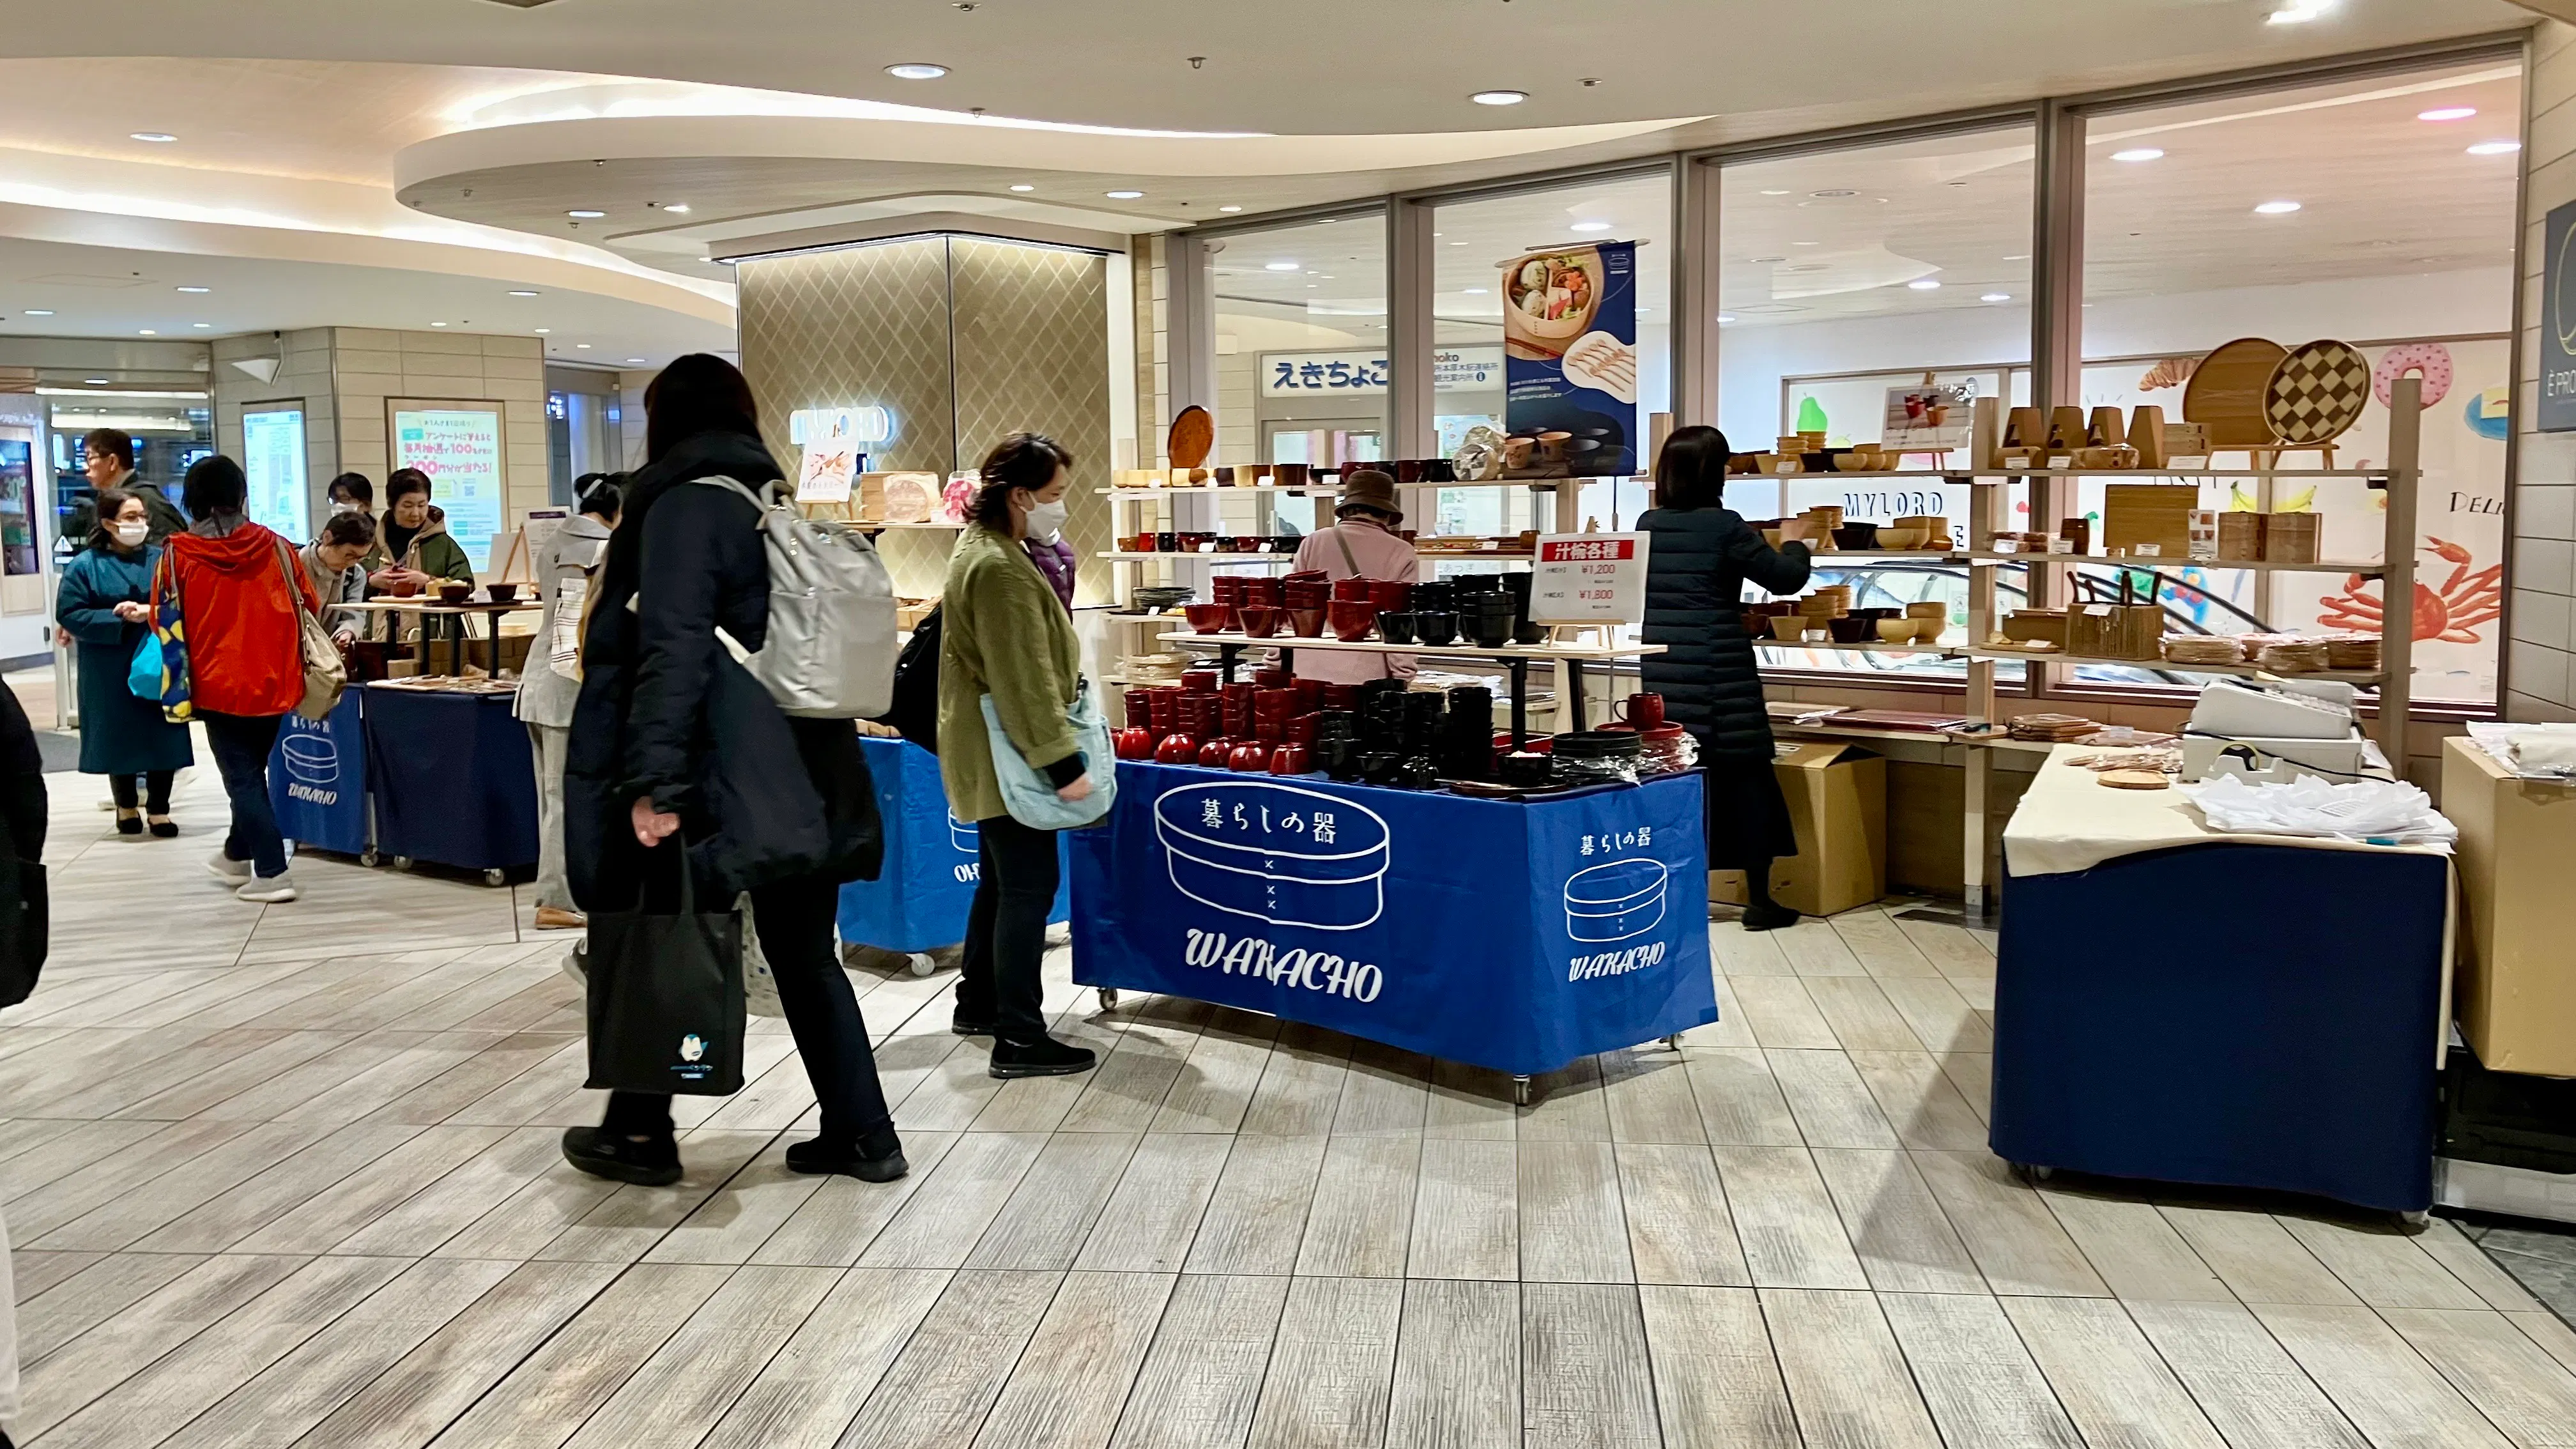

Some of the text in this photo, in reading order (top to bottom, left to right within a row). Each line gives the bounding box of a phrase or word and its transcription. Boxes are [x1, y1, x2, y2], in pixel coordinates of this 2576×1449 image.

[1843, 492, 1943, 517] MYLORD
[2450, 491, 2504, 515] DELI
[1581, 564, 1615, 574] ¥1,200
[1201, 798, 1337, 844] 暮らしの器
[1580, 827, 1651, 856] 暮らしの器
[1185, 928, 1383, 1002] WAKACHO
[1568, 941, 1665, 982] WAKACHO
